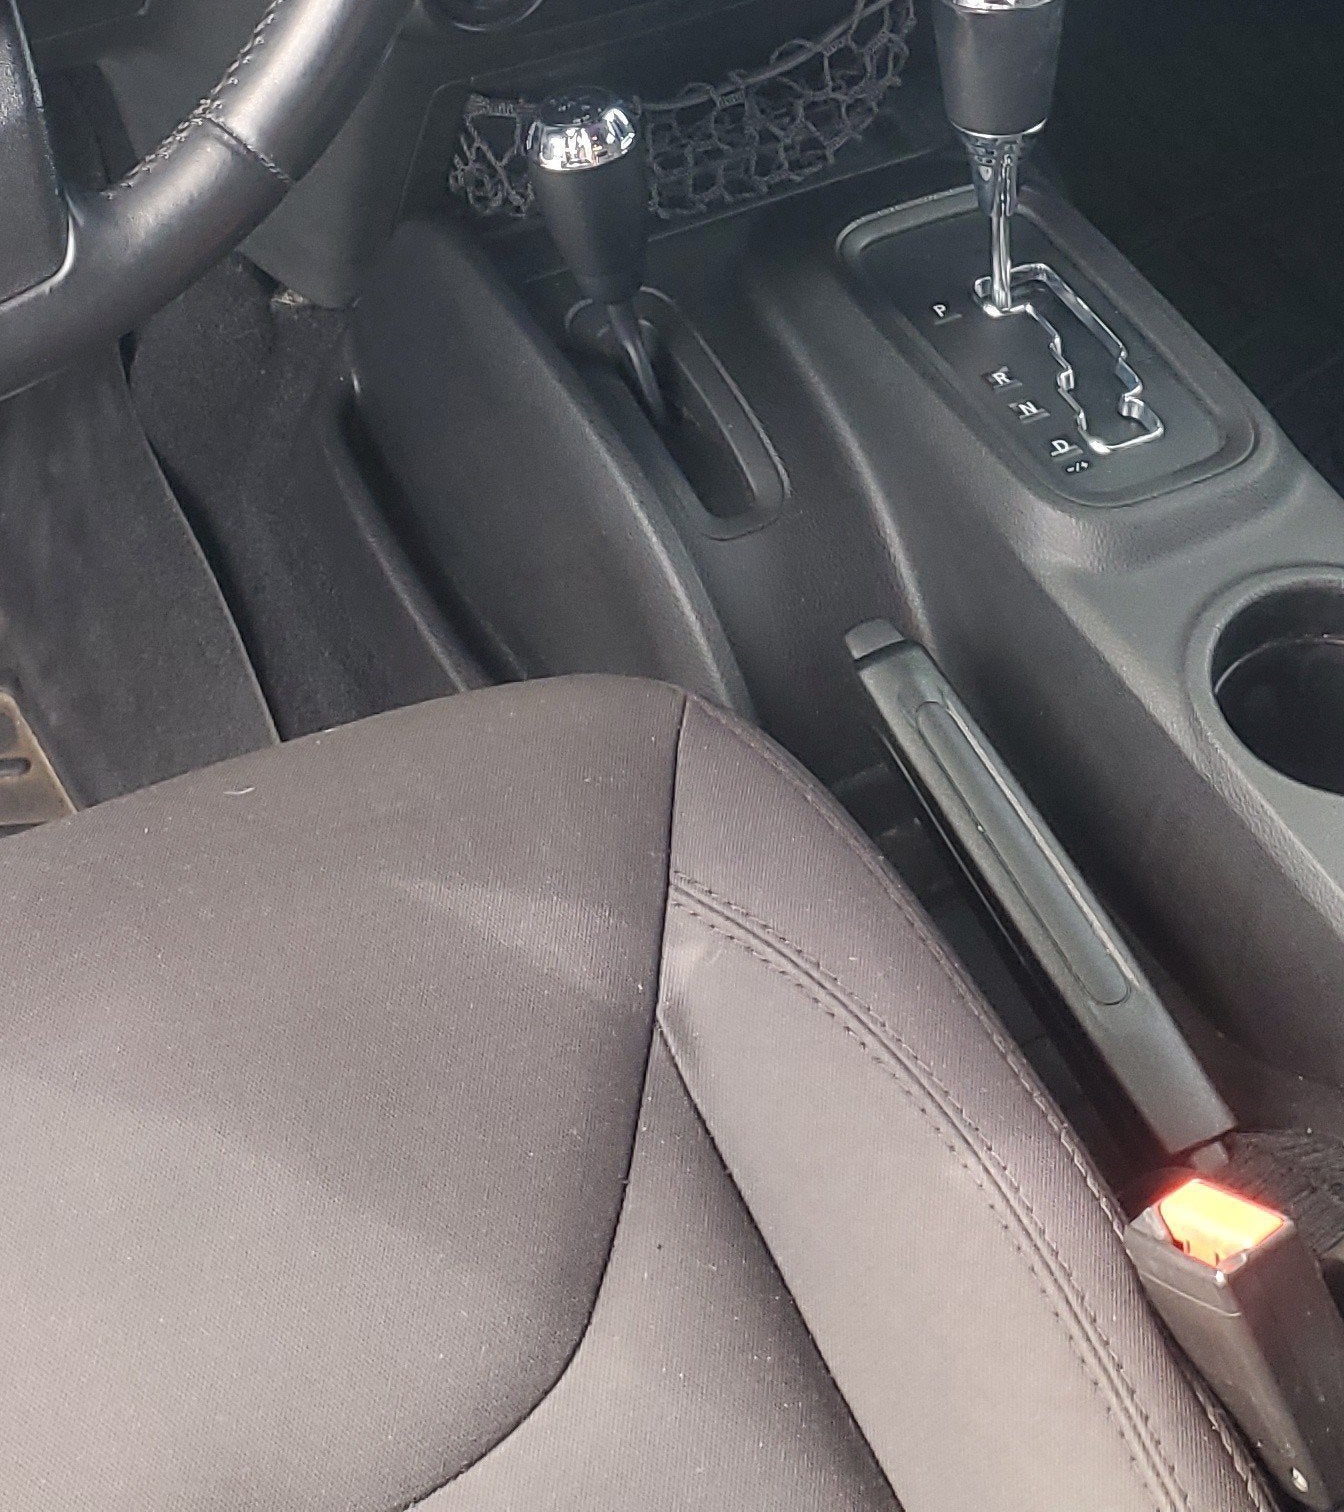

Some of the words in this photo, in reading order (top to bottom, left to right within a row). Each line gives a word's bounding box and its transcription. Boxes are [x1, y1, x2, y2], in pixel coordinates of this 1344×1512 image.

[933, 304, 947, 317] P
[992, 371, 1011, 385] R
[1018, 401, 1038, 416] N
[1051, 439, 1070, 455] D
